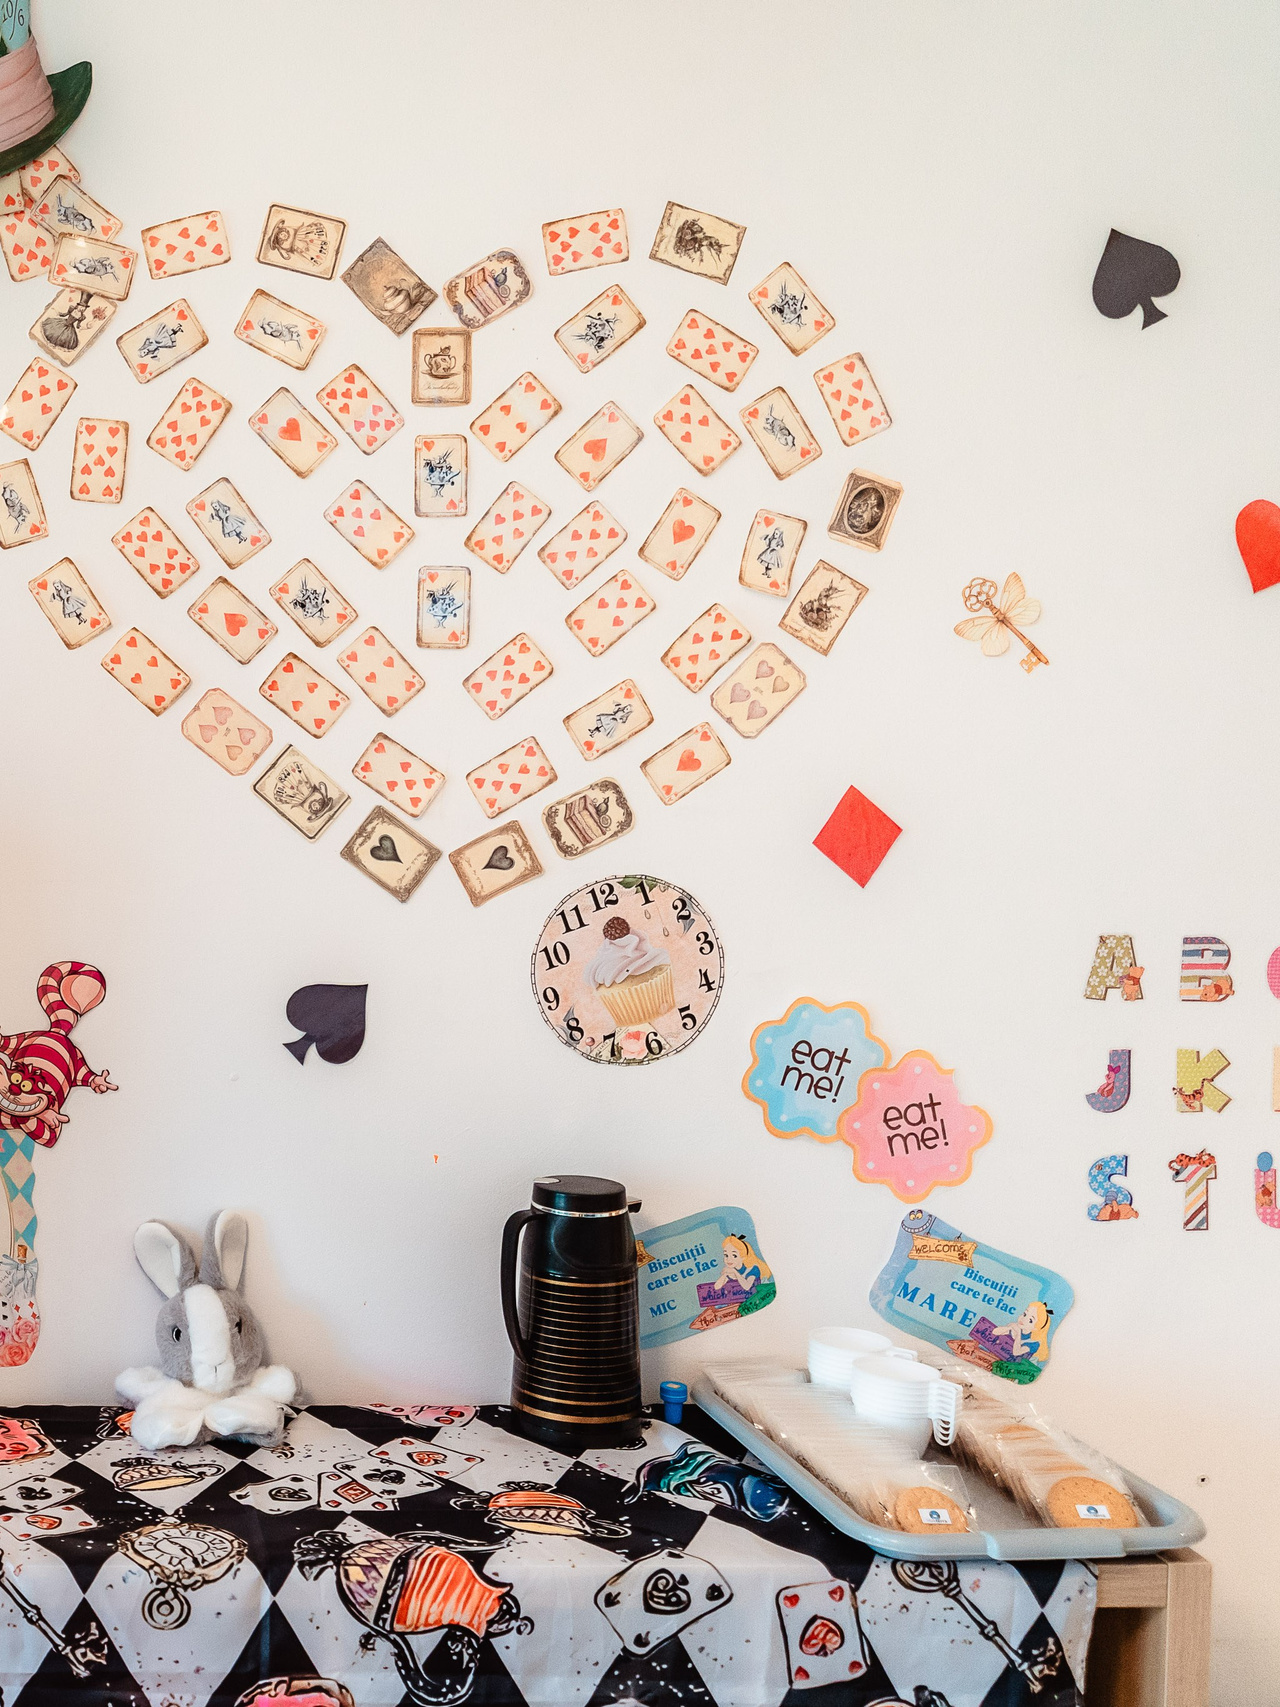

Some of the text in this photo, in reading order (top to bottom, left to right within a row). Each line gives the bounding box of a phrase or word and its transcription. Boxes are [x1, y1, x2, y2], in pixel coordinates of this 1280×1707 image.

[586, 882, 619, 913] 12
[635, 880, 655, 906] 1
[556, 904, 589, 935] 11
[672, 897, 692, 923] 2
[539, 941, 571, 971] 10
[696, 931, 714, 956] 3
[698, 968, 716, 993] 4
[1083, 934, 1144, 1001] A
[1180, 936, 1234, 1002] B
[542, 986, 560, 1011] 9
[566, 1017, 584, 1042] 8
[677, 1004, 697, 1030] 5
[602, 1032, 616, 1058] 7
[645, 1031, 663, 1055] 6
[791, 1040, 852, 1076] eat
[780, 1065, 845, 1103] me!
[1085, 1048, 1232, 1114] J K
[883, 1093, 942, 1130] eat
[887, 1118, 949, 1157] me!
[1087, 1154, 1138, 1221] S
[647, 1243, 706, 1274] Biscuiții
[647, 1258, 719, 1291] care te fac
[963, 1267, 1019, 1299] Biscuiții
[649, 1299, 677, 1318] MIC
[897, 1281, 977, 1328] MARE
[950, 1280, 1017, 1315] care te fac
